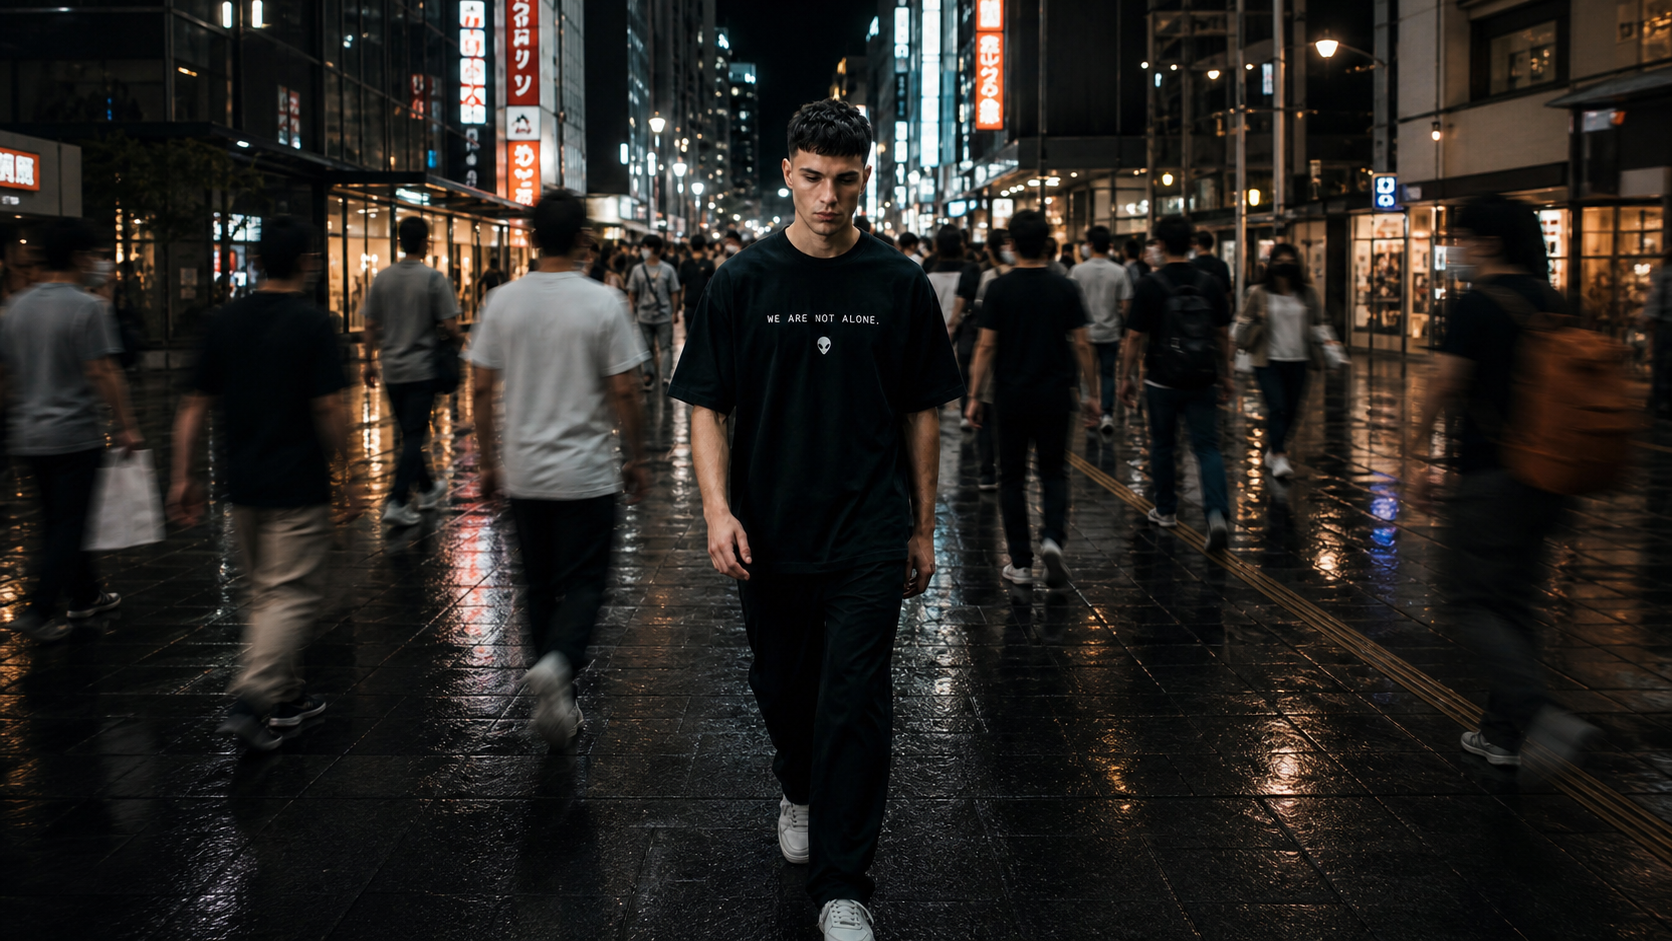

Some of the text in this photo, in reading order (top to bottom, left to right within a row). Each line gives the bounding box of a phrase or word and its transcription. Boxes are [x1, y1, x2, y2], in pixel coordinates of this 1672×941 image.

[766, 313, 880, 325] WE ARE NOT ALONE.
